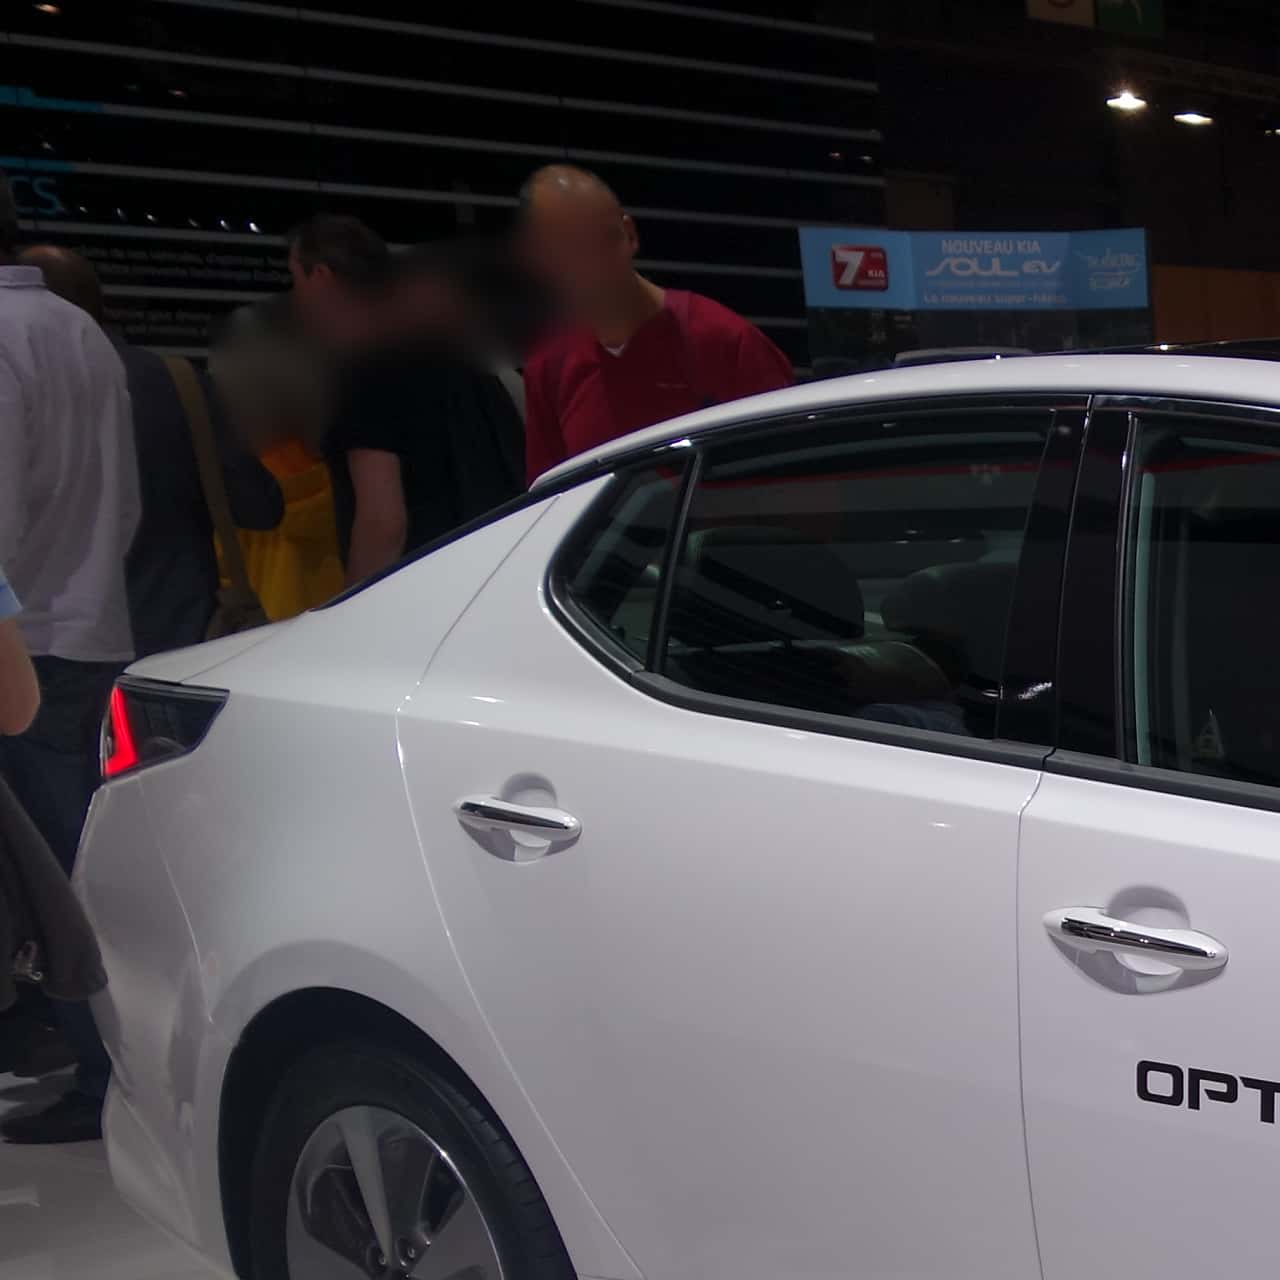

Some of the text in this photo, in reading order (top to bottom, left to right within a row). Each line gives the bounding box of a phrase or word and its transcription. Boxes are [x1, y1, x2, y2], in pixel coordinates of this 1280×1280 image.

[942, 239, 1041, 255] NOUVEAU KIA
[835, 249, 865, 287] 7
[867, 269, 886, 279] KIA
[925, 257, 1019, 277] SOUL
